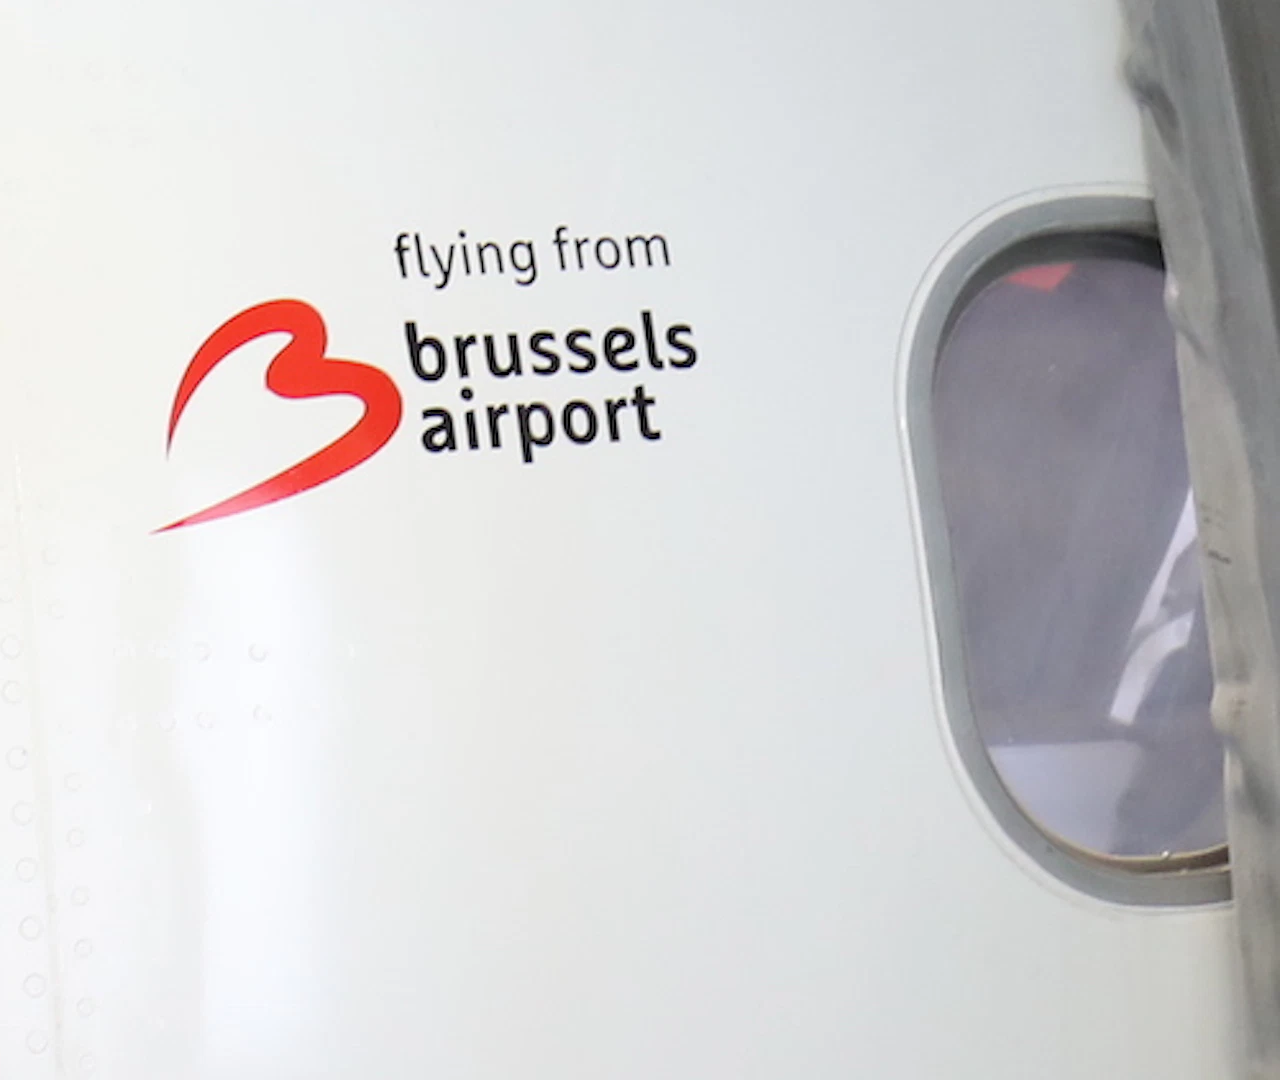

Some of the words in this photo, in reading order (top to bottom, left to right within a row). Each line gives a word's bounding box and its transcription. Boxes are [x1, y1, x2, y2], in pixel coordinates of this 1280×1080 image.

[394, 229, 538, 289] flying
[552, 226, 671, 271] from
[404, 310, 698, 382] brussels
[420, 385, 662, 464] airport
